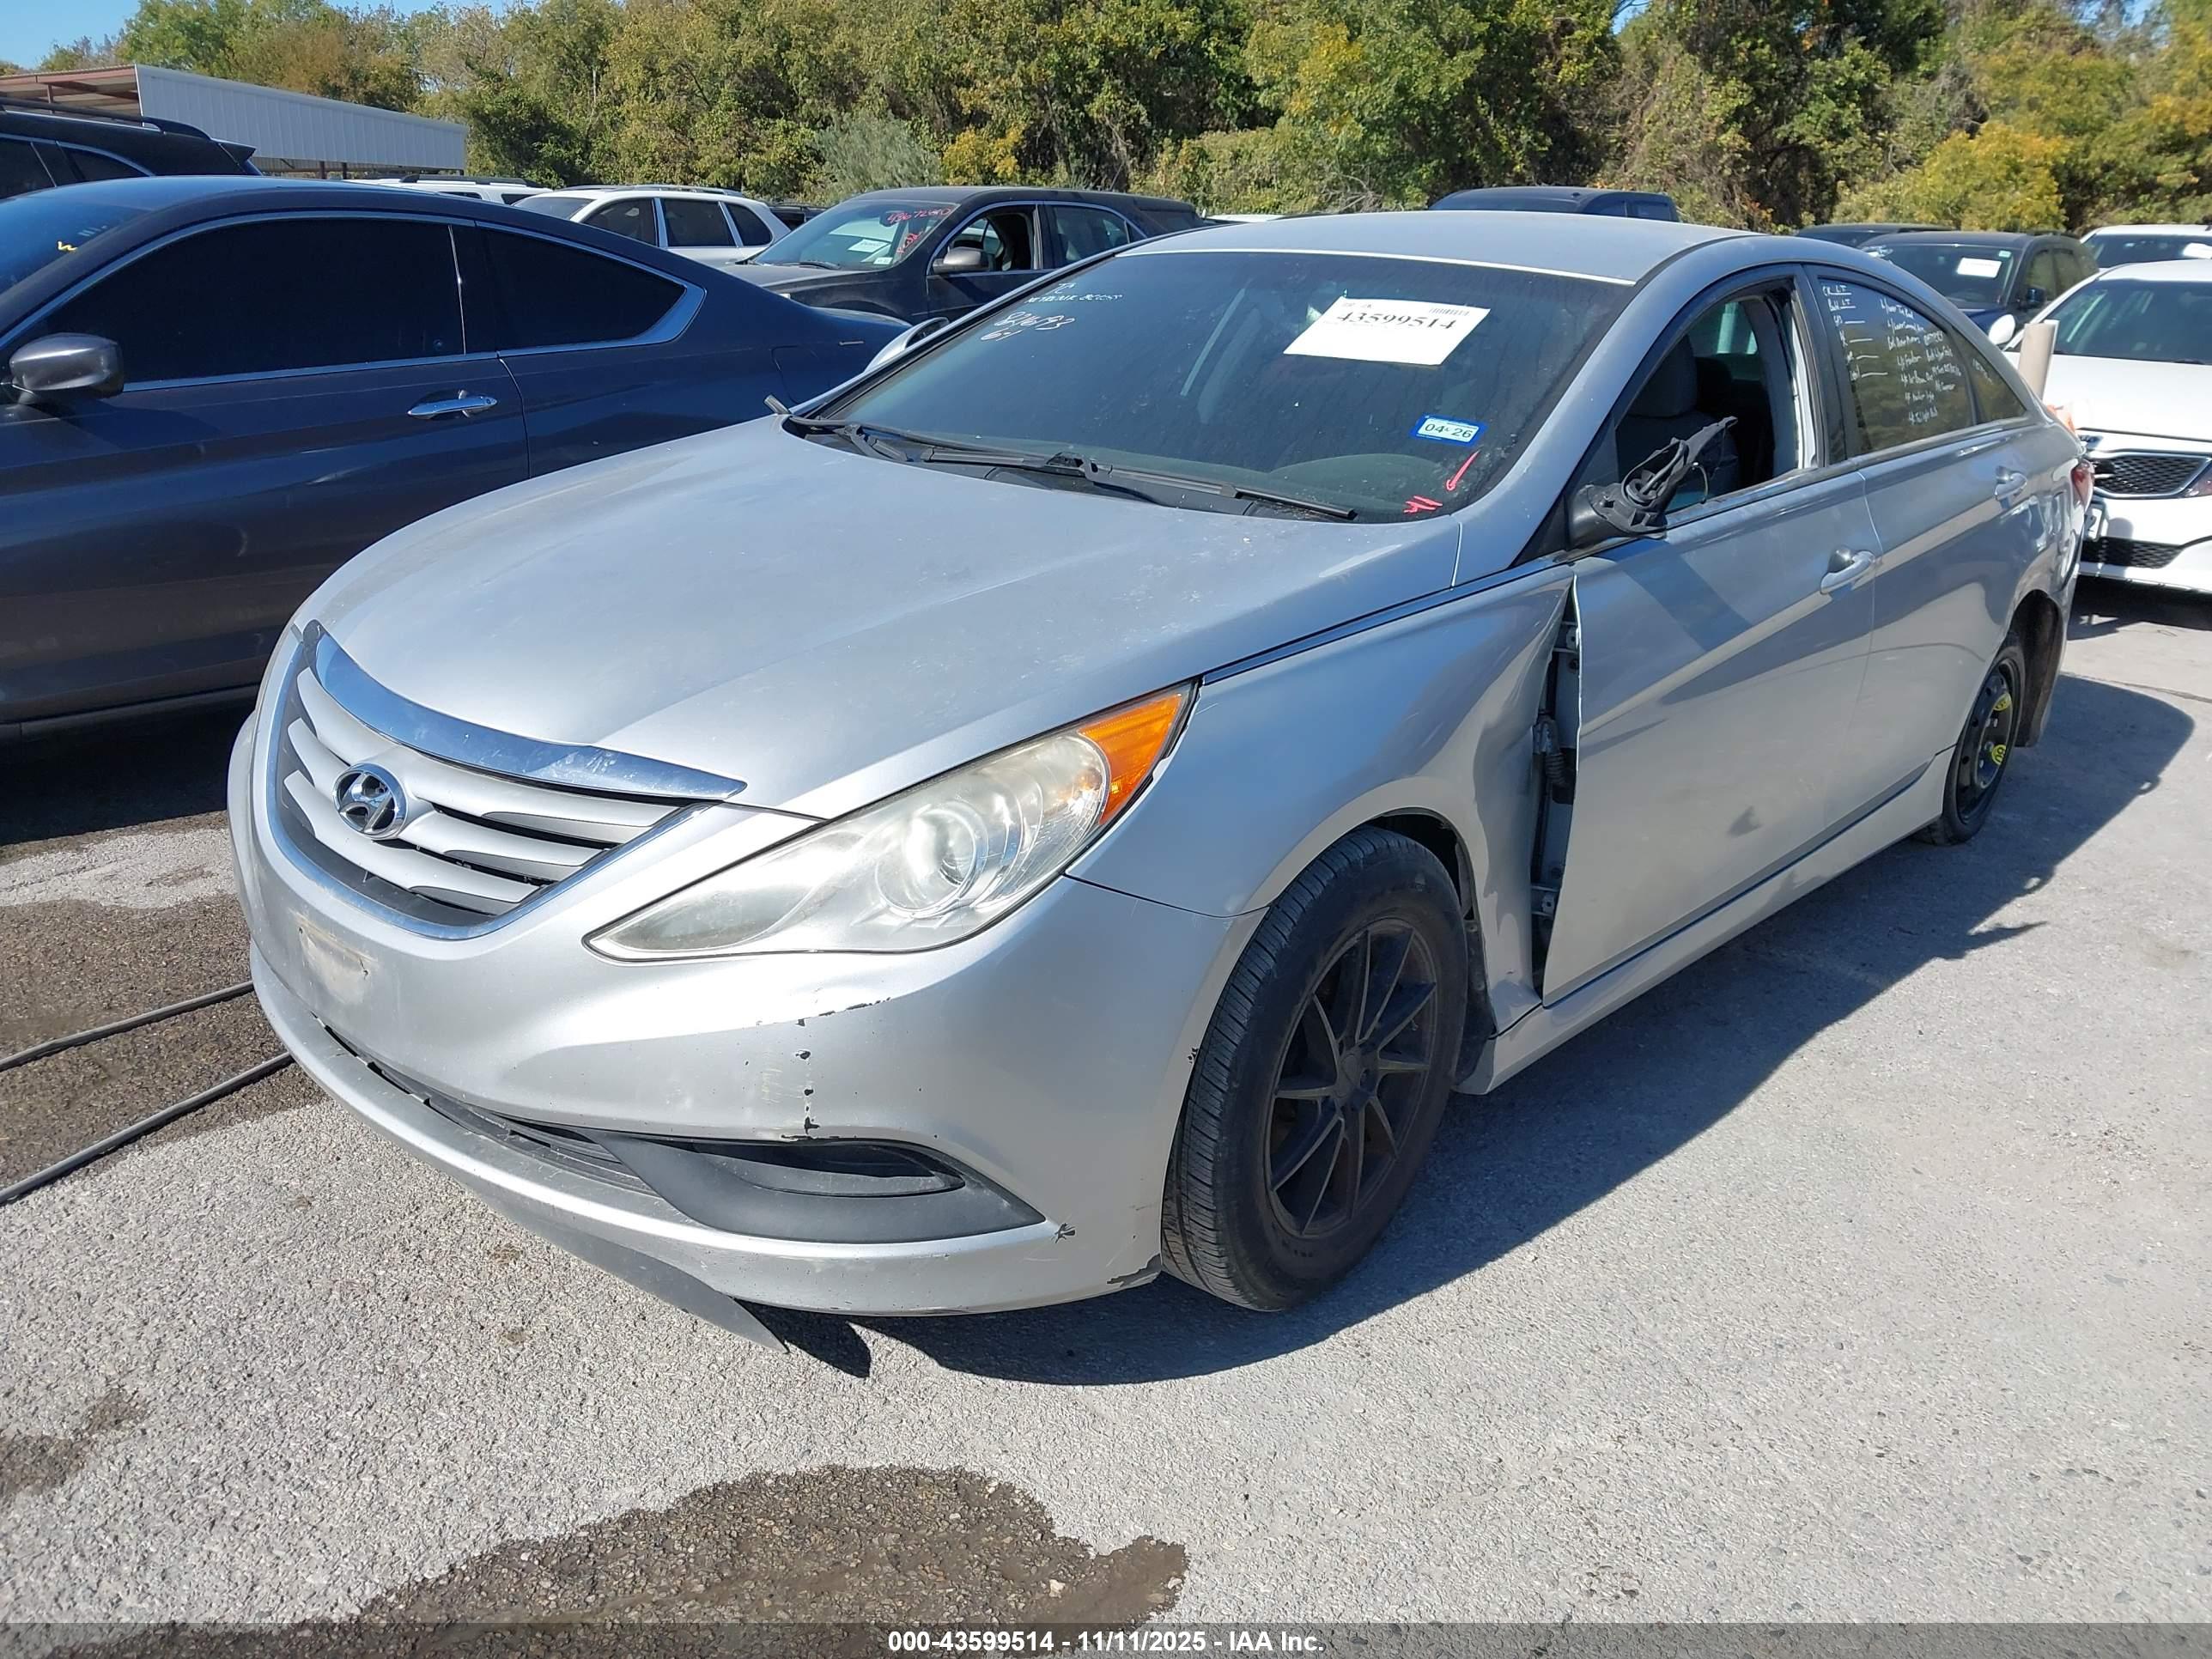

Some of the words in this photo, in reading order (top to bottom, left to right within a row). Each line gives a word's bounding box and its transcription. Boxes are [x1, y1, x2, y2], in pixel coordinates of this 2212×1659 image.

[1337, 311, 1457, 330] 43599514
[1425, 423, 1444, 434] 04
[1451, 428, 1474, 439] 26
